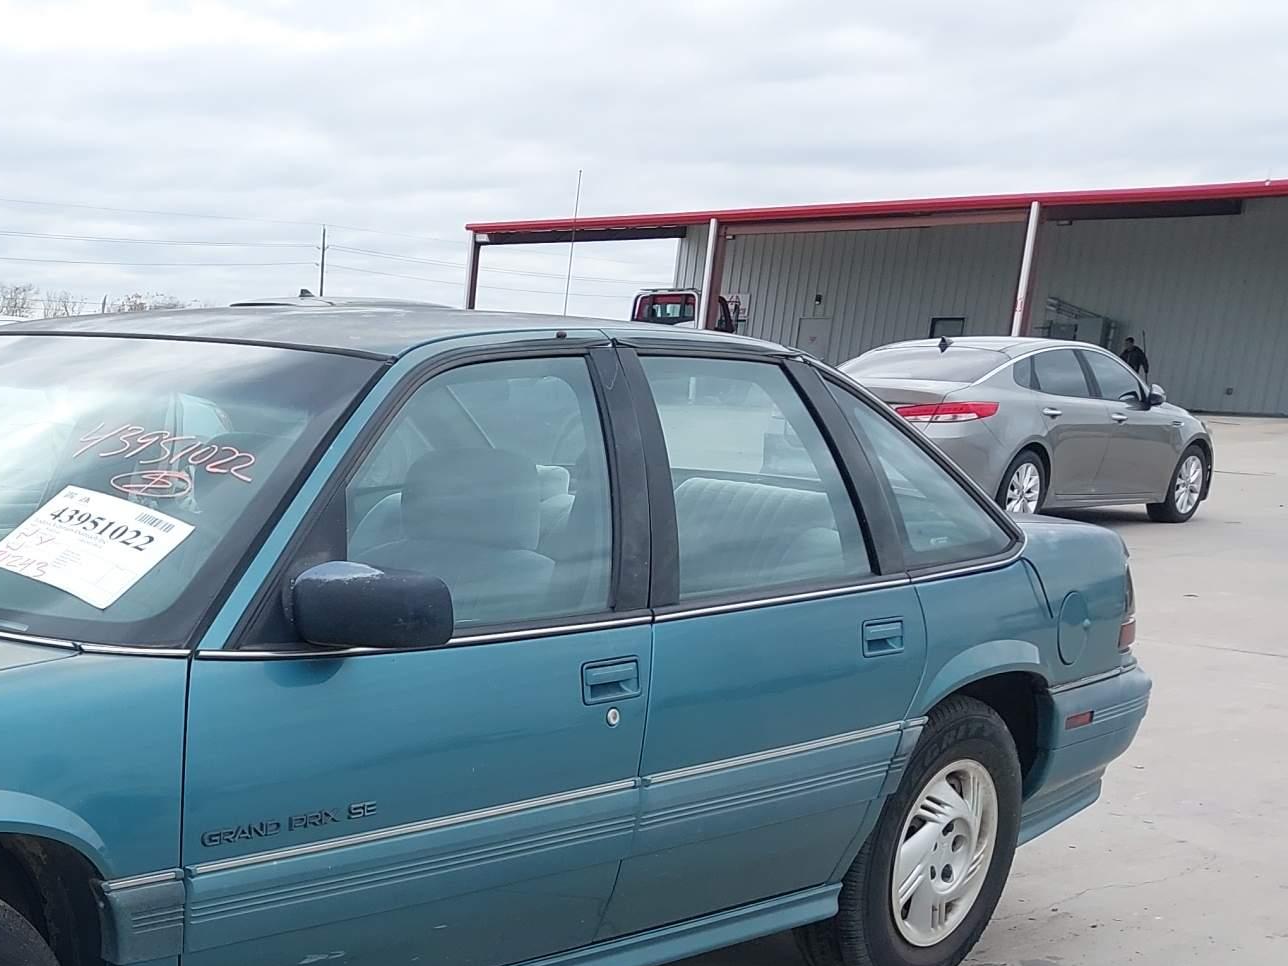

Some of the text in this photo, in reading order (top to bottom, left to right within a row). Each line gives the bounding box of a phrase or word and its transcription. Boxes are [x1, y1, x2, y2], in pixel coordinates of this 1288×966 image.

[72, 422, 256, 482] 43951022
[50, 506, 155, 552] 43951022
[201, 801, 378, 848] GRAND PRIX SE
